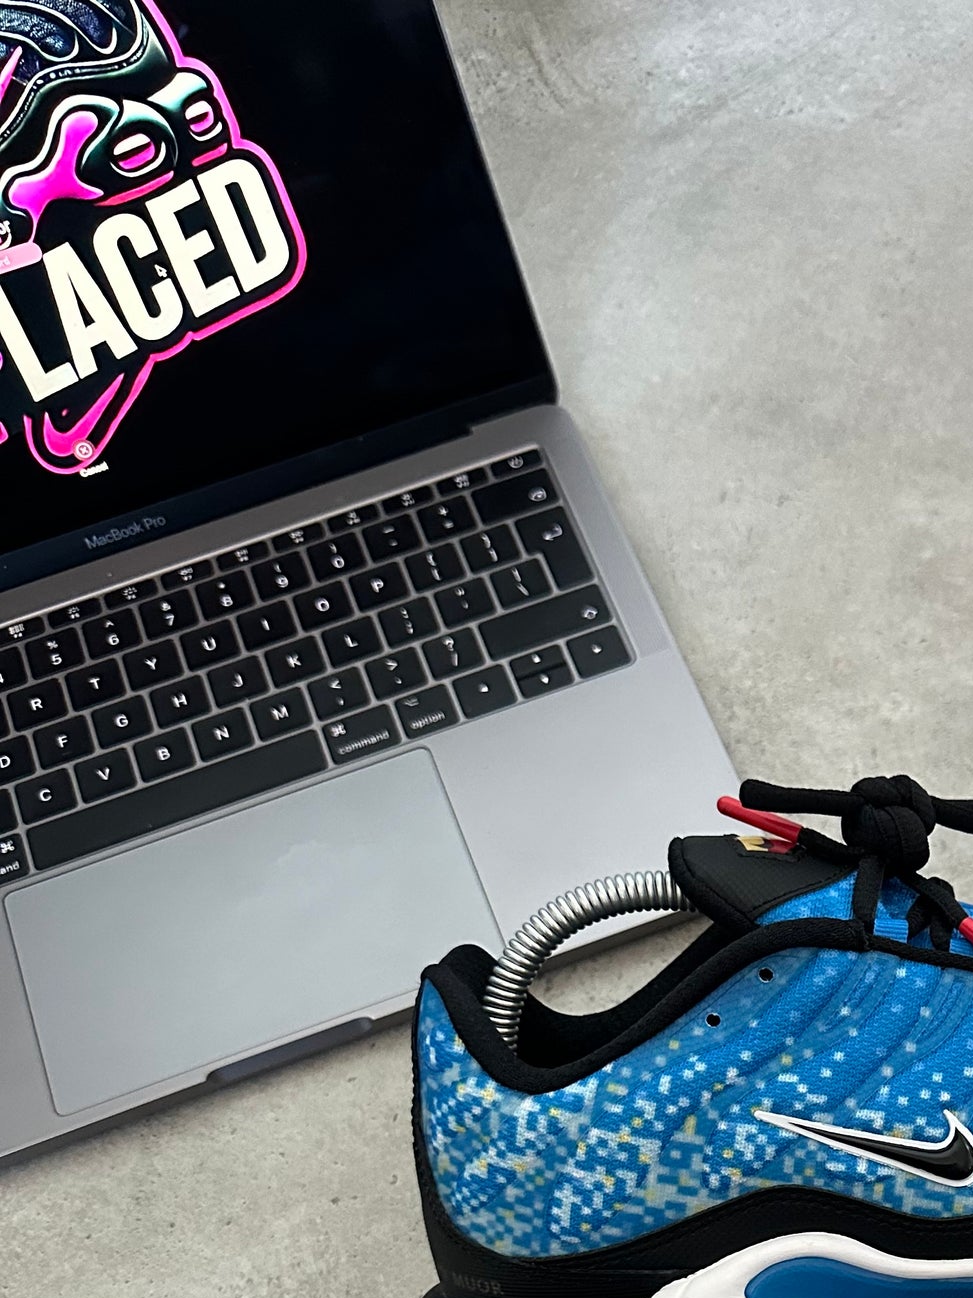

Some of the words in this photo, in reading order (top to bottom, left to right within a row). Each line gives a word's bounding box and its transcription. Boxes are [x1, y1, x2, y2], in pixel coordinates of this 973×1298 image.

[0, 158, 290, 402] LACED
[84, 522, 144, 549] MacBook
[142, 516, 167, 530] Pro
[370, 577, 384, 593] P
[164, 613, 175, 627] 7
[107, 634, 120, 646] 6
[201, 636, 217, 651] U
[344, 634, 359, 648] L
[51, 654, 62, 665] 5
[144, 657, 157, 670] Y
[285, 653, 302, 668] K
[88, 677, 100, 690] T
[232, 672, 244, 688] J
[30, 698, 43, 710] R
[172, 692, 188, 708] H
[270, 704, 290, 721] M
[114, 714, 129, 728] G
[213, 725, 230, 740] N
[57, 734, 68, 748] F
[338, 729, 390, 755] command
[155, 746, 171, 761] B
[0, 756, 11, 769] D
[96, 767, 110, 781] V
[38, 788, 52, 801] C
